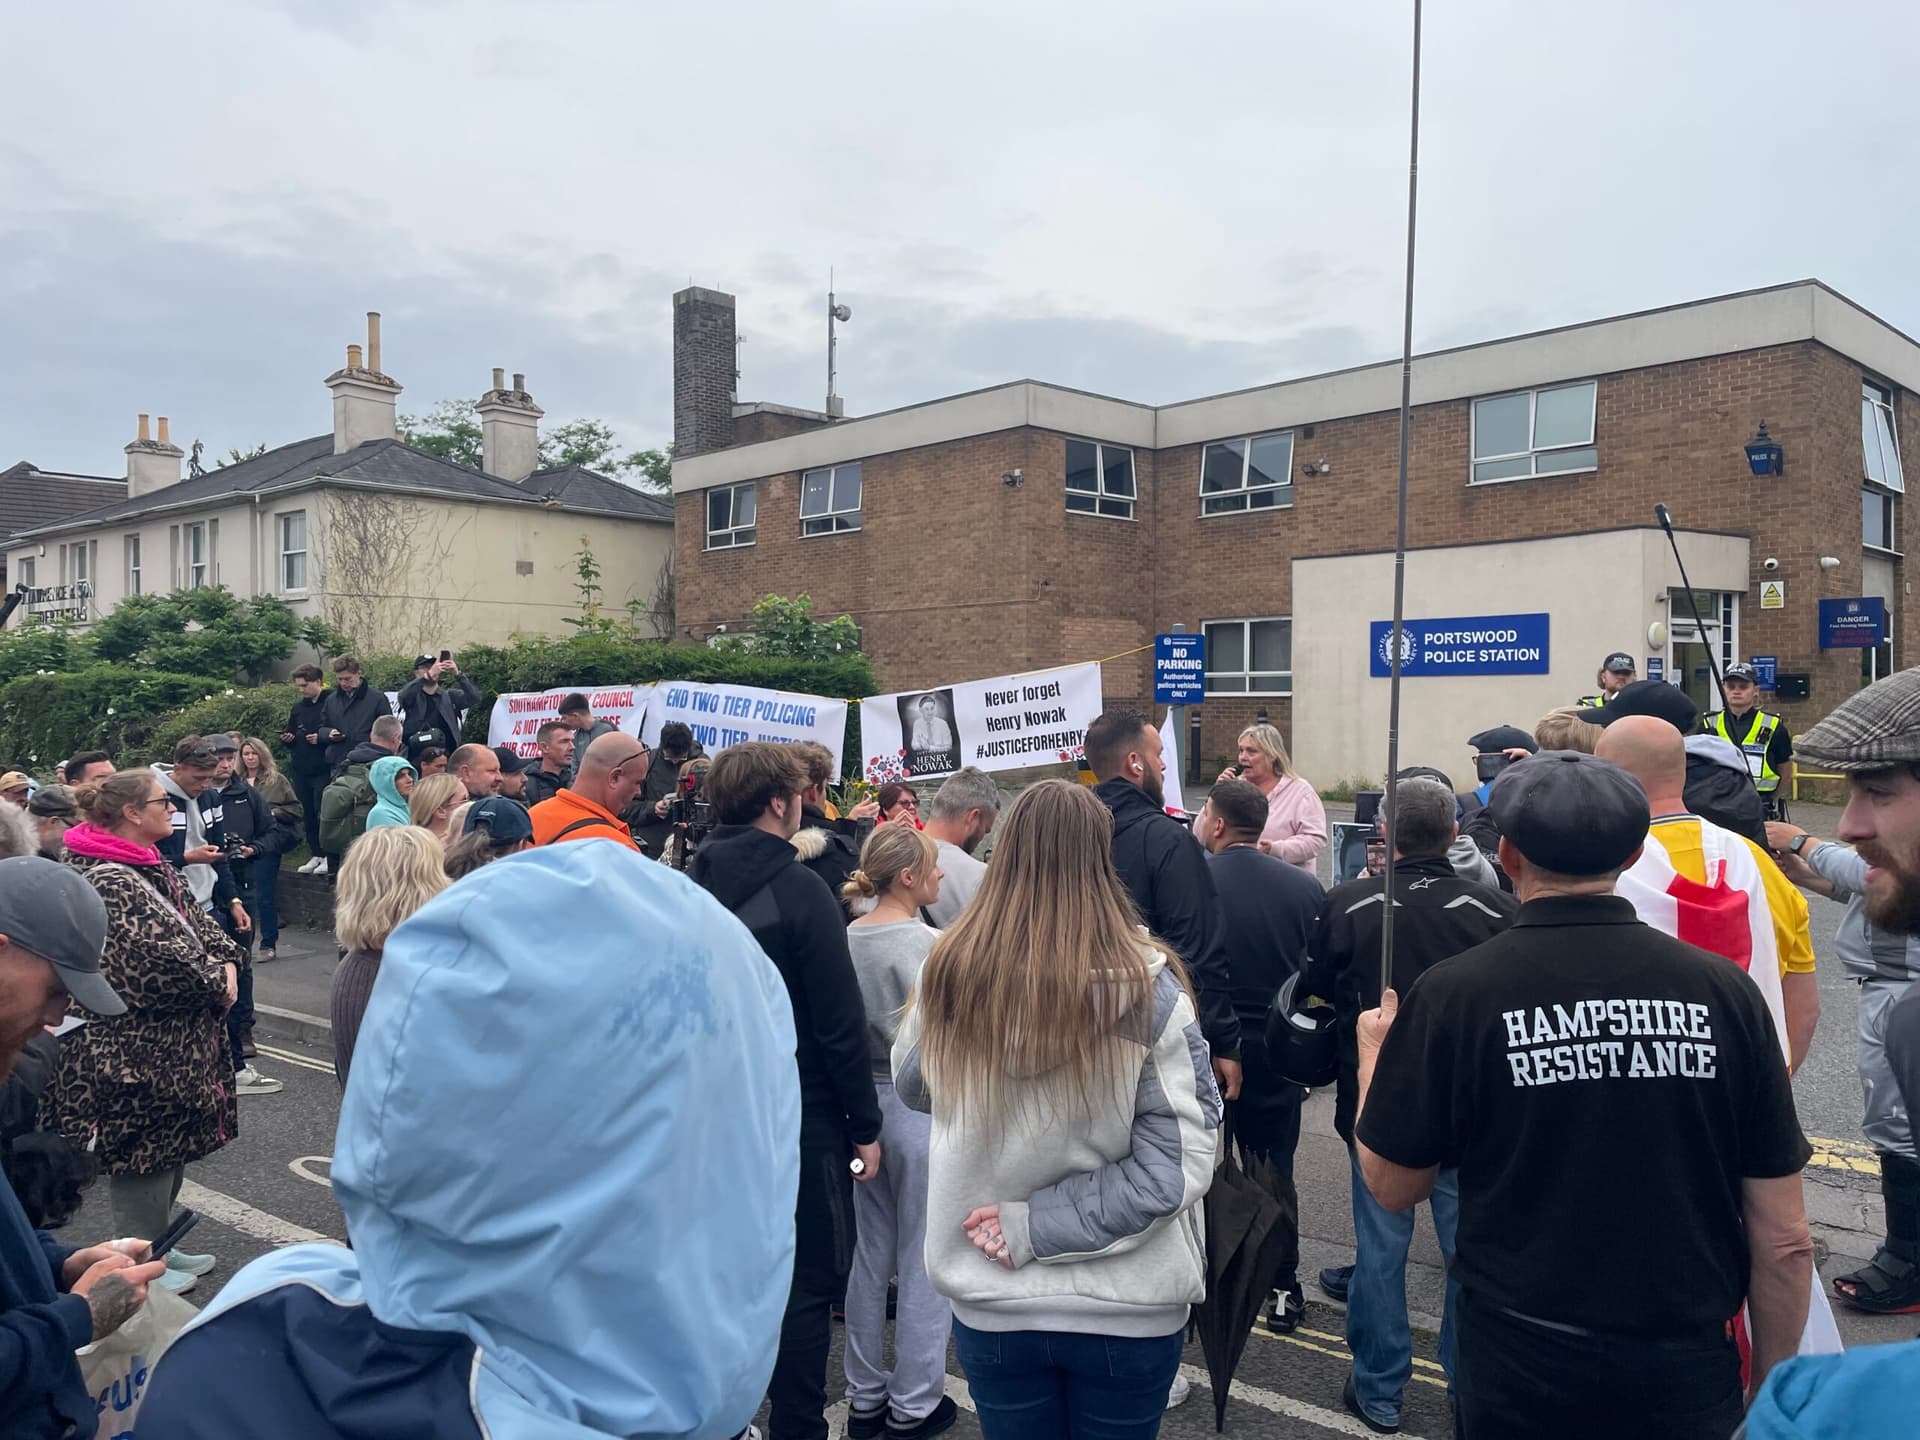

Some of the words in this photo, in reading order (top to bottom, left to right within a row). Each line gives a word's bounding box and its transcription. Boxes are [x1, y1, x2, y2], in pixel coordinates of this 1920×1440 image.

[1424, 630, 1518, 645] PORTSWOOD
[1173, 648, 1188, 658] NO
[1424, 650, 1476, 664] POLICE
[1480, 648, 1540, 662] STATION
[1157, 660, 1203, 670] PARKING
[592, 691, 634, 709] COUNCIL
[984, 689, 1019, 707] Never
[1023, 681, 1061, 701] forget
[666, 688, 690, 709] END
[692, 691, 720, 713] TWO
[722, 695, 752, 718] TIER
[753, 699, 816, 728] POLICING
[512, 720, 521, 736] IS
[523, 719, 539, 735] NOT
[986, 714, 1021, 732] Henry
[1024, 706, 1066, 726] Nowak
[690, 723, 717, 747] TWO
[721, 728, 749, 748] TIER
[976, 729, 1083, 759] #JUSTICEFORHENRY
[912, 760, 953, 773] NOWAK
[916, 753, 948, 764] HENRY
[1502, 999, 1712, 1048] HAMPSHIRE
[1506, 1041, 1717, 1087] RESISTANCE
